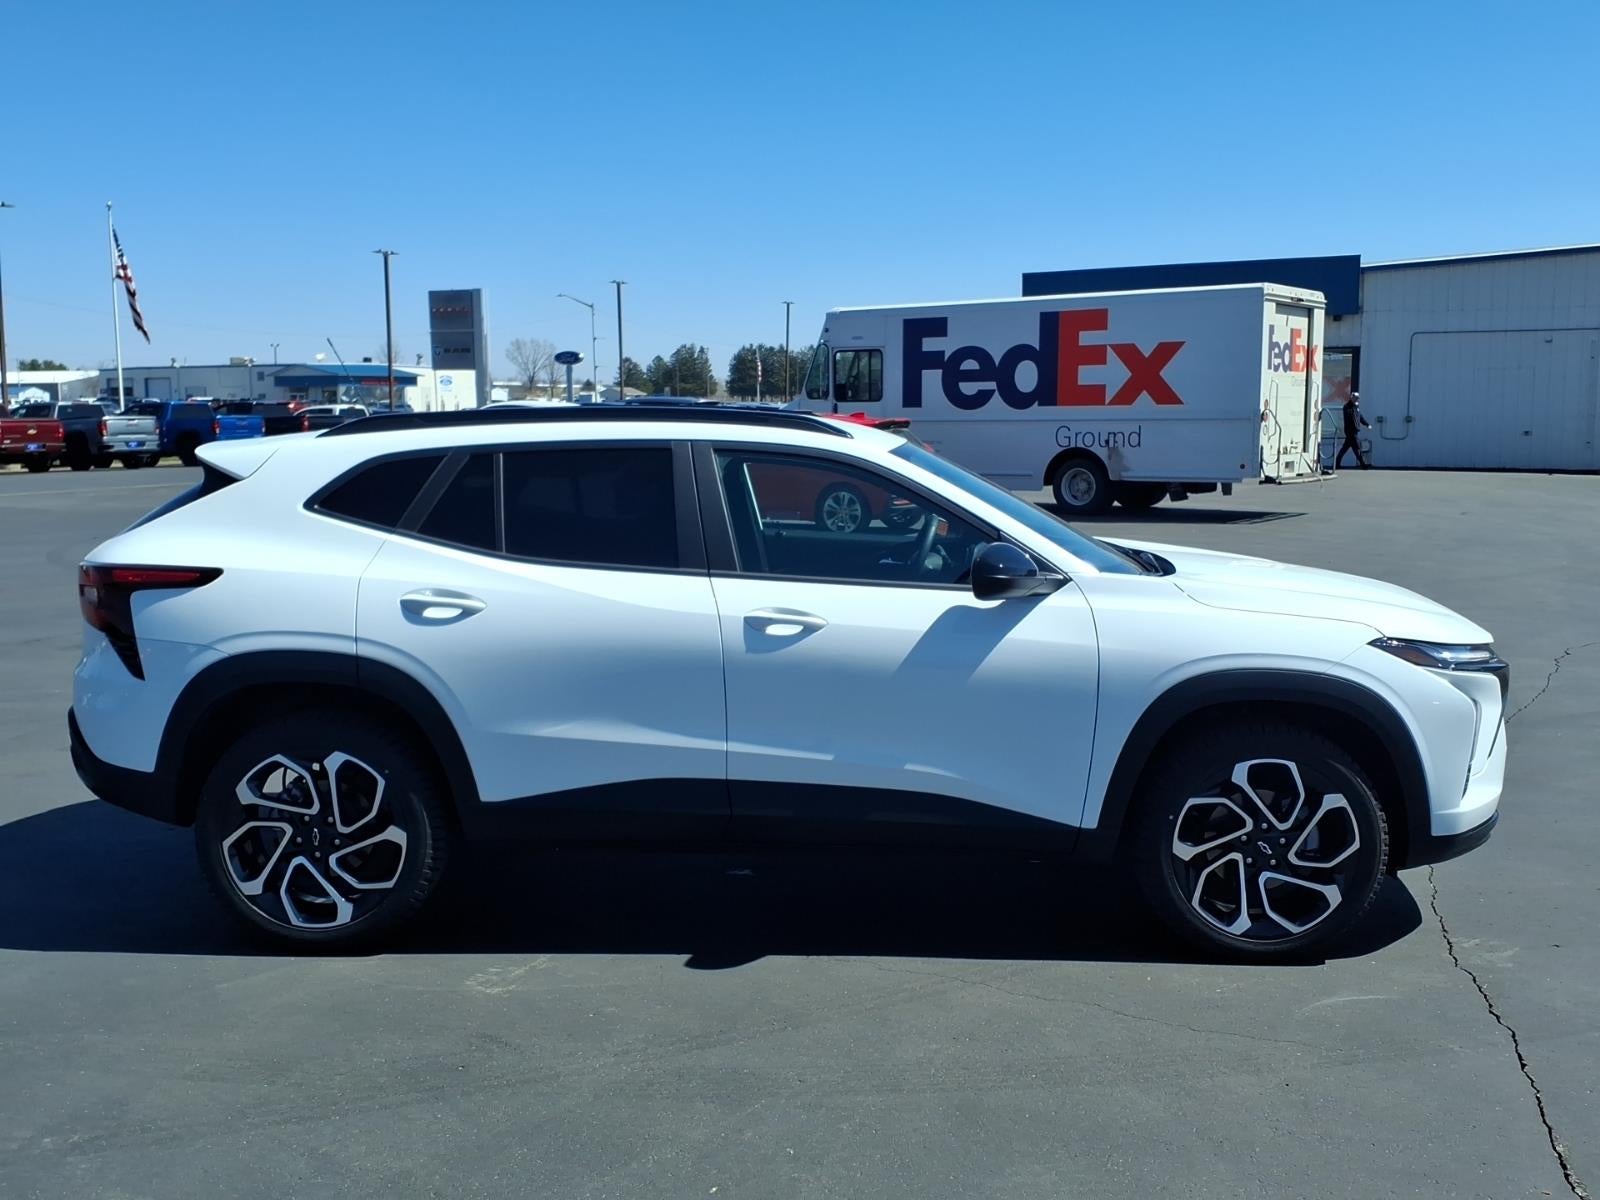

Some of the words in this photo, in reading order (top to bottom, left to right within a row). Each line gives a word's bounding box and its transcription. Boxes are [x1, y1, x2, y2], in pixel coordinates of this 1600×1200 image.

[902, 308, 1186, 410] FedEx
[1267, 324, 1318, 374] FedEx
[1055, 424, 1141, 448] Ground
